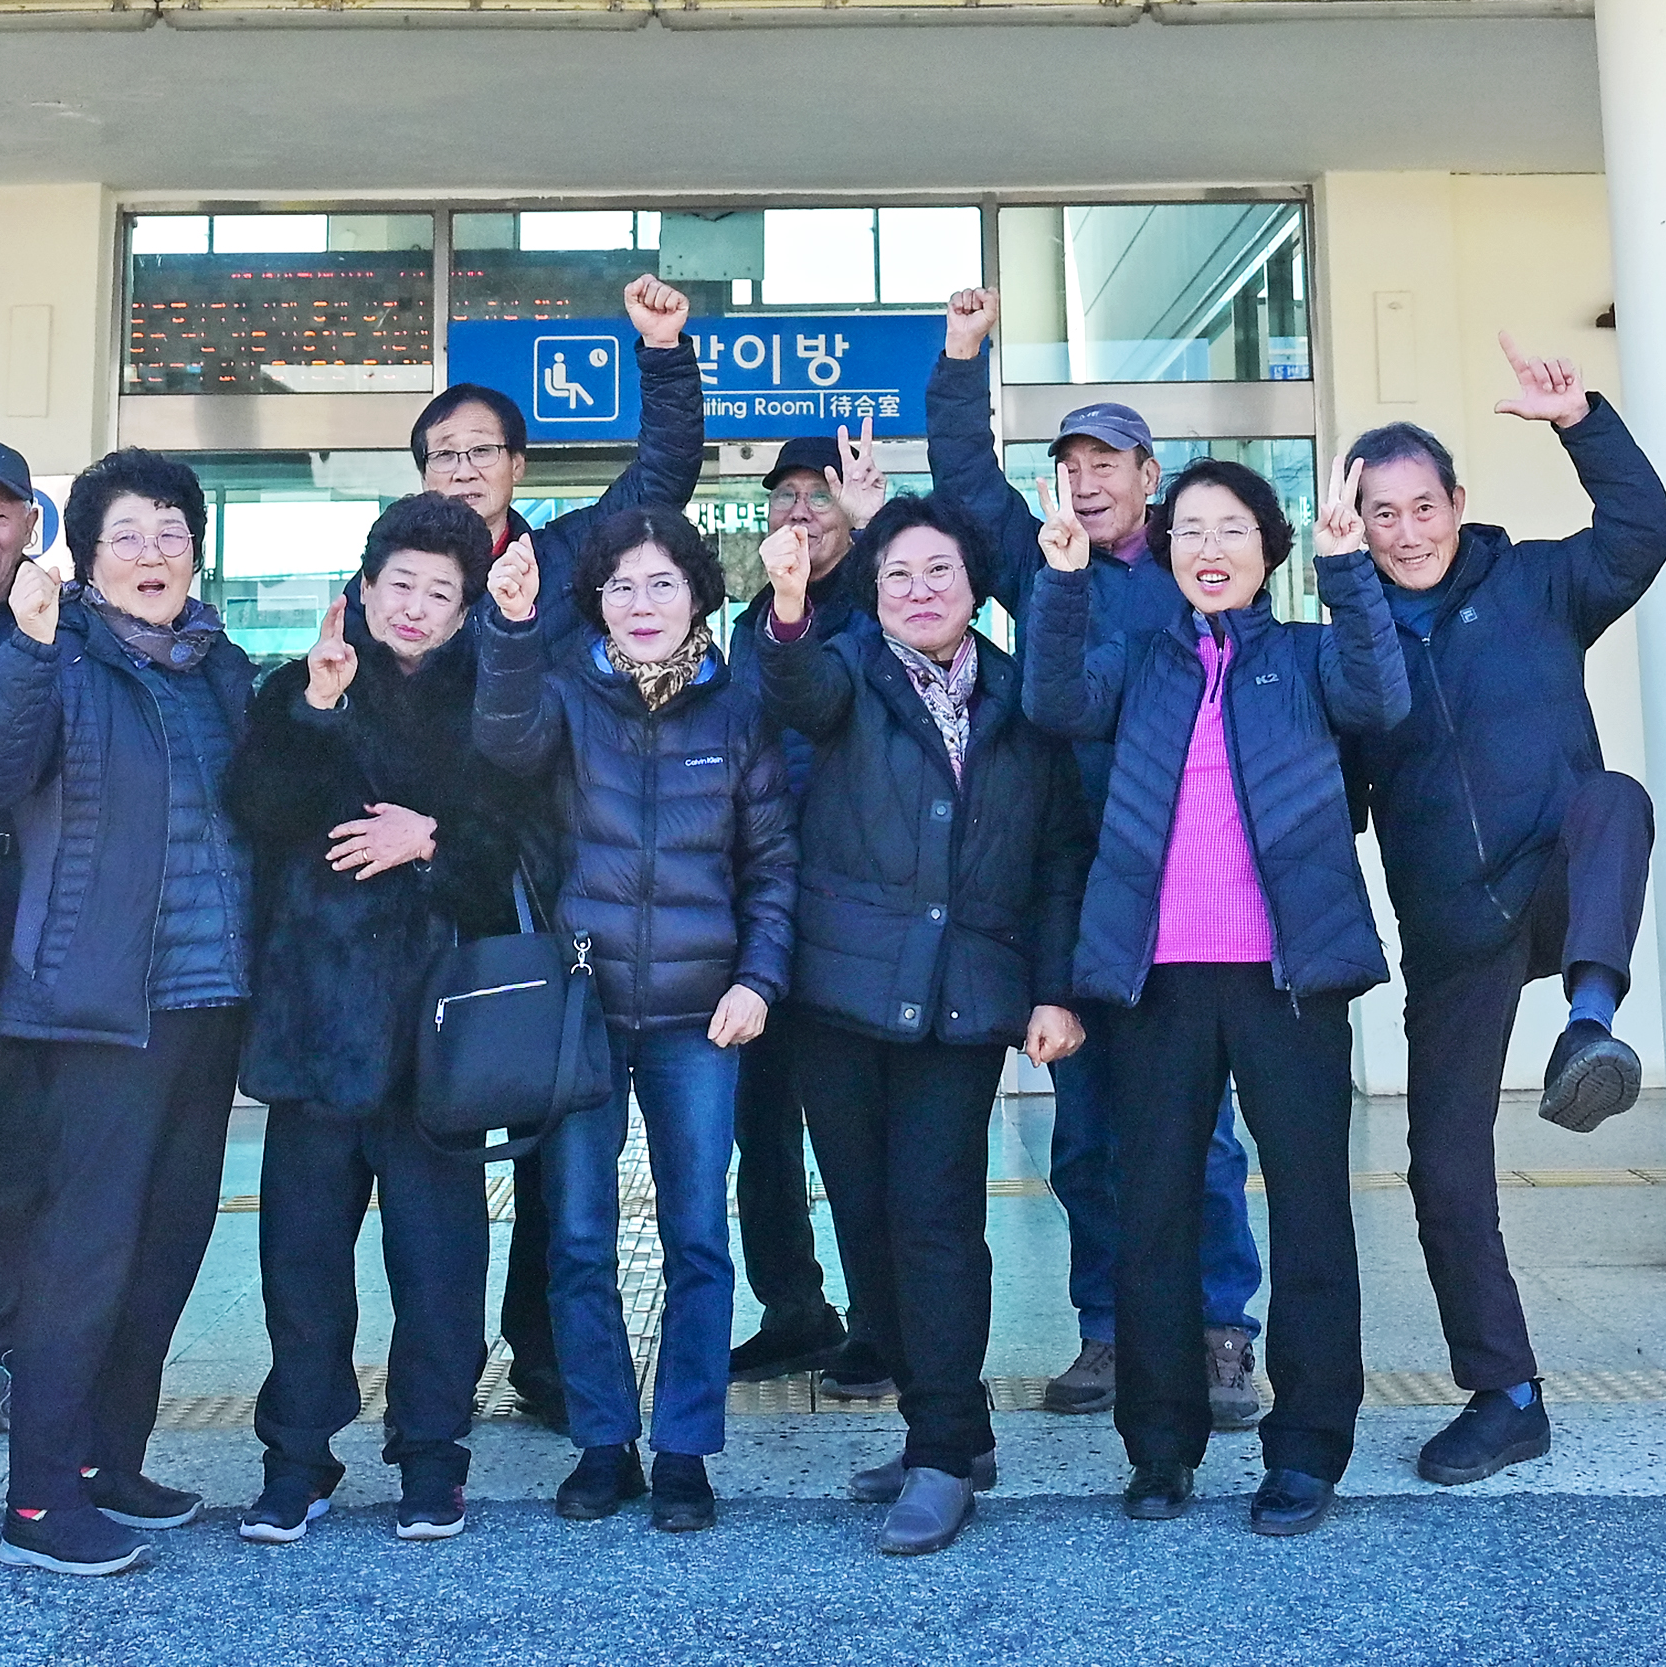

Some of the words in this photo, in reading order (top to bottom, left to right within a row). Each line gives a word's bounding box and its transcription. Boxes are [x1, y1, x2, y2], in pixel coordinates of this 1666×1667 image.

[703, 397, 747, 418] iting
[755, 399, 815, 415] Room
[829, 395, 900, 417] 待合室
[1255, 672, 1280, 686] K2
